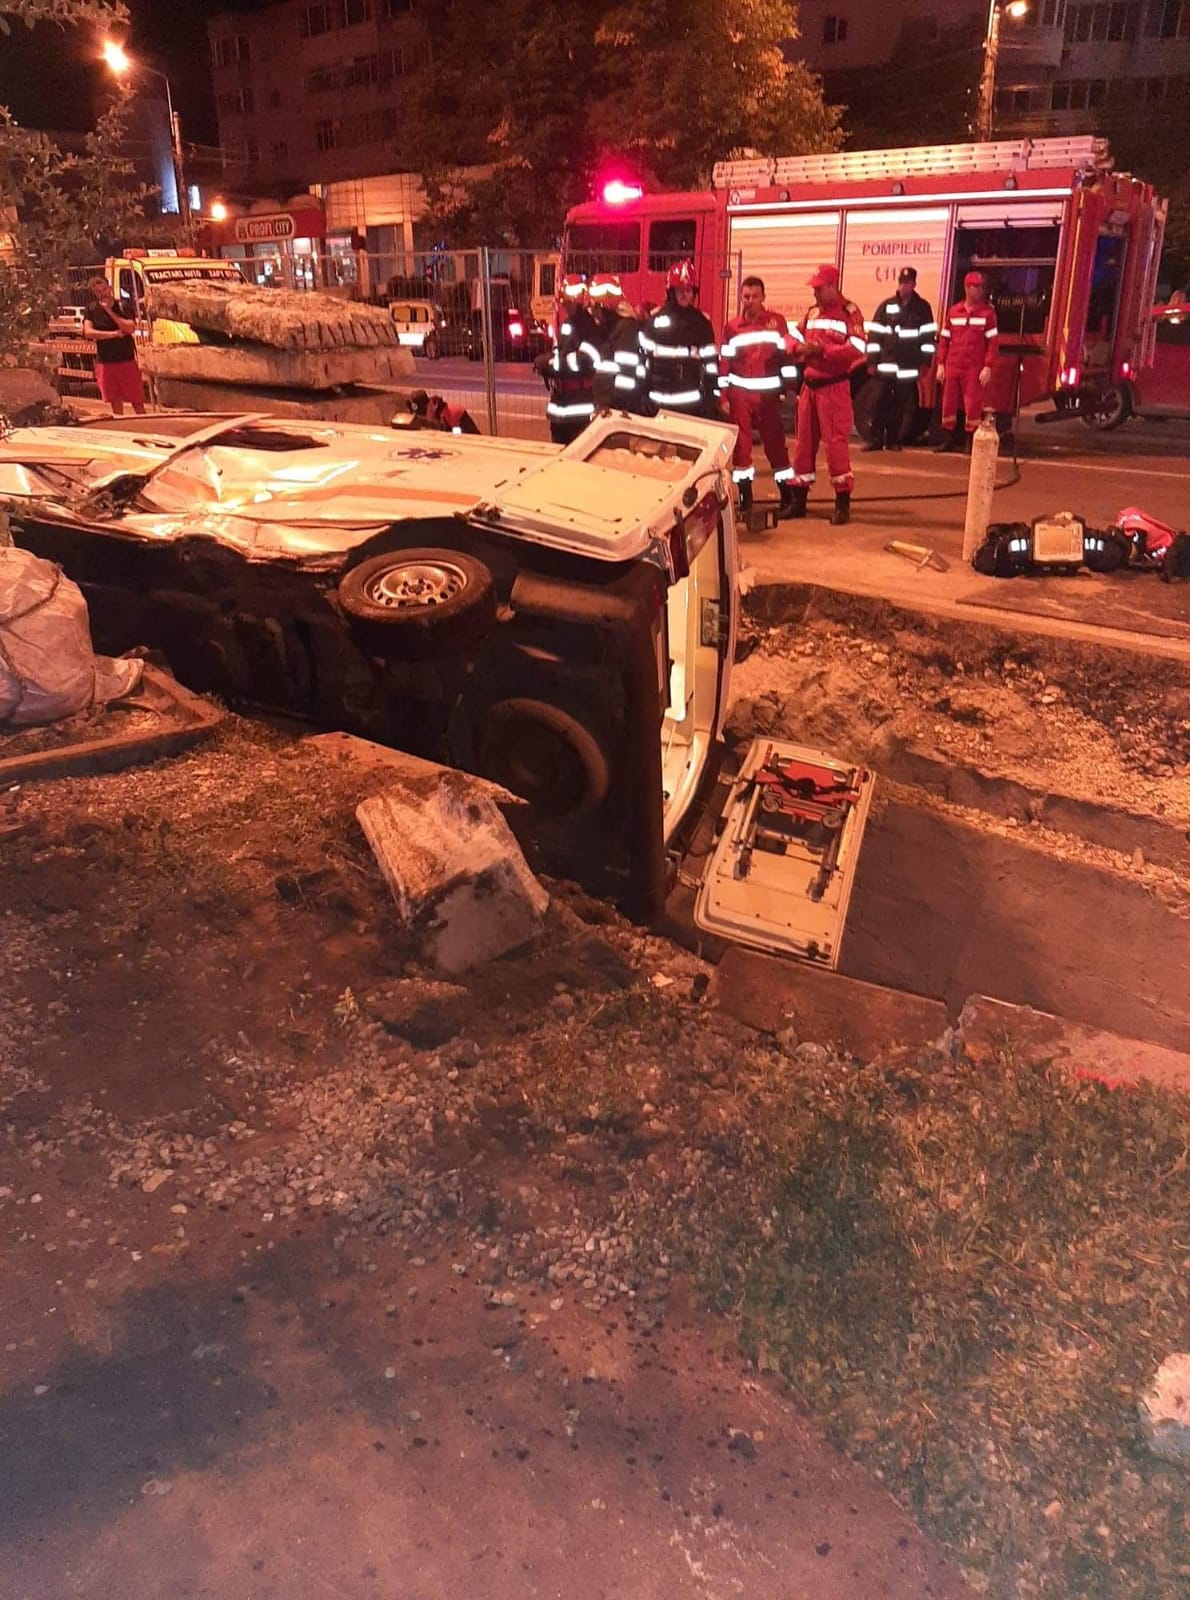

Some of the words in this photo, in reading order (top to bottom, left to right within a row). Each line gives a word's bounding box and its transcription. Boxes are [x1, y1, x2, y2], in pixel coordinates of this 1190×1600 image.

[249, 222, 273, 236] PROFI
[275, 220, 290, 235] CITY
[862, 241, 930, 256] POMPIERII
